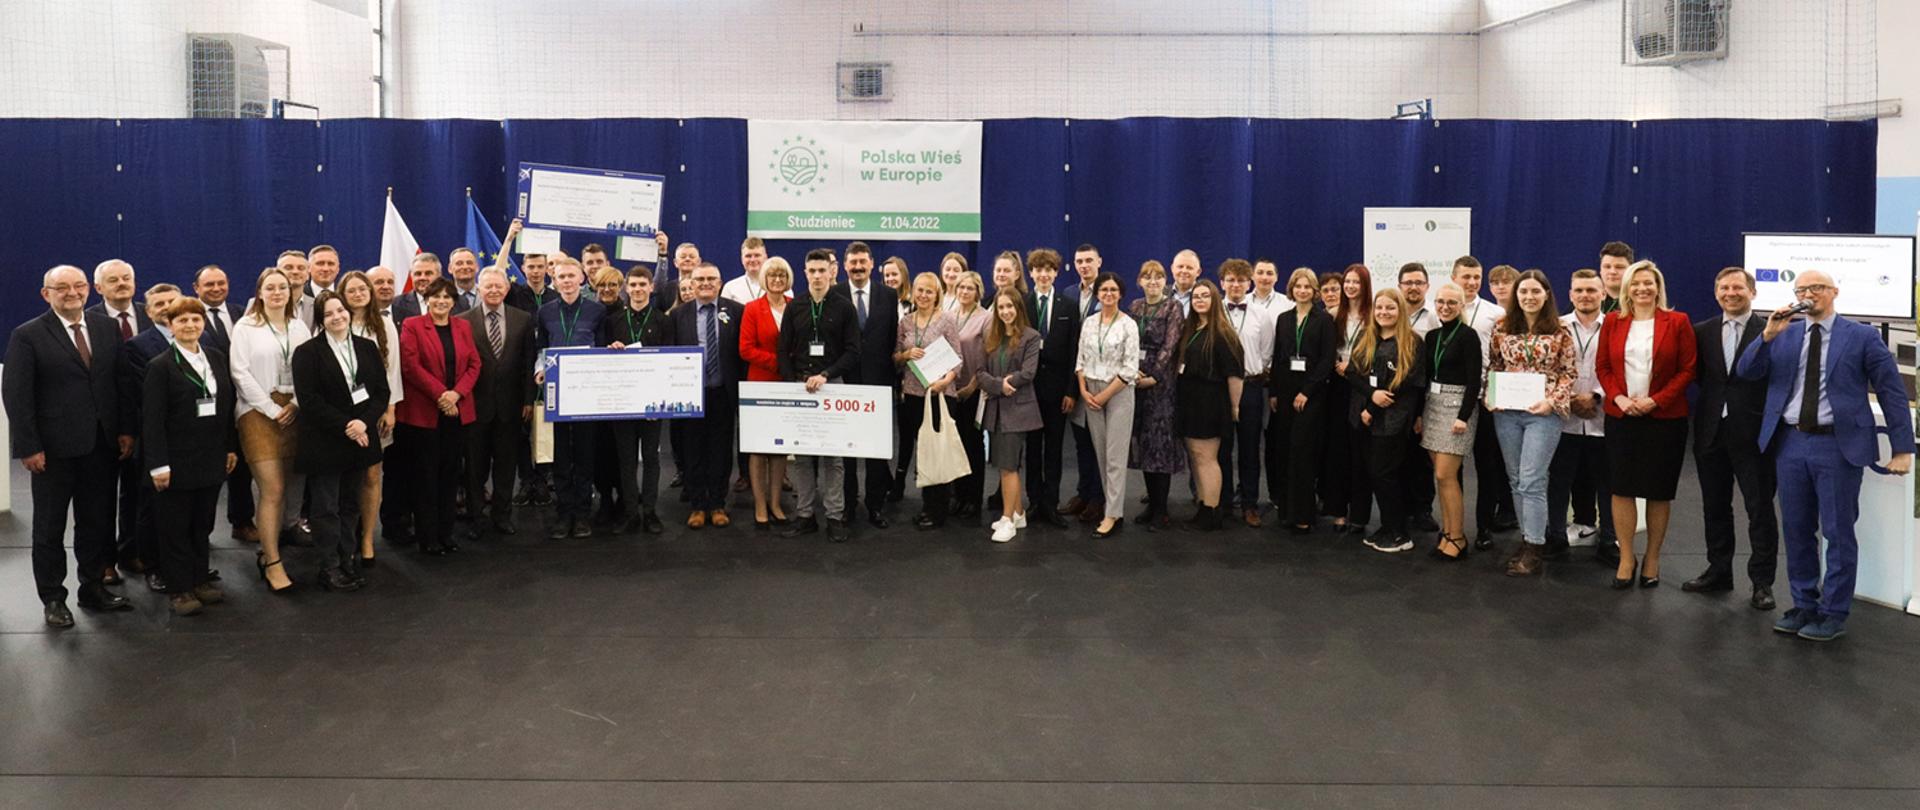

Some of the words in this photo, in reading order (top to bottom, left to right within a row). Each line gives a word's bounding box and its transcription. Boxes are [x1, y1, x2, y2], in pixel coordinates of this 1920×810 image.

[861, 150, 916, 164] Polska
[921, 149, 962, 165] Wieś
[860, 170, 875, 181] w
[879, 168, 943, 185] Europie
[787, 215, 856, 229] Studzieniec
[880, 216, 940, 230] 21.04.2022
[823, 399, 832, 411] 5
[835, 399, 860, 412] 000
[863, 400, 876, 413] zł
